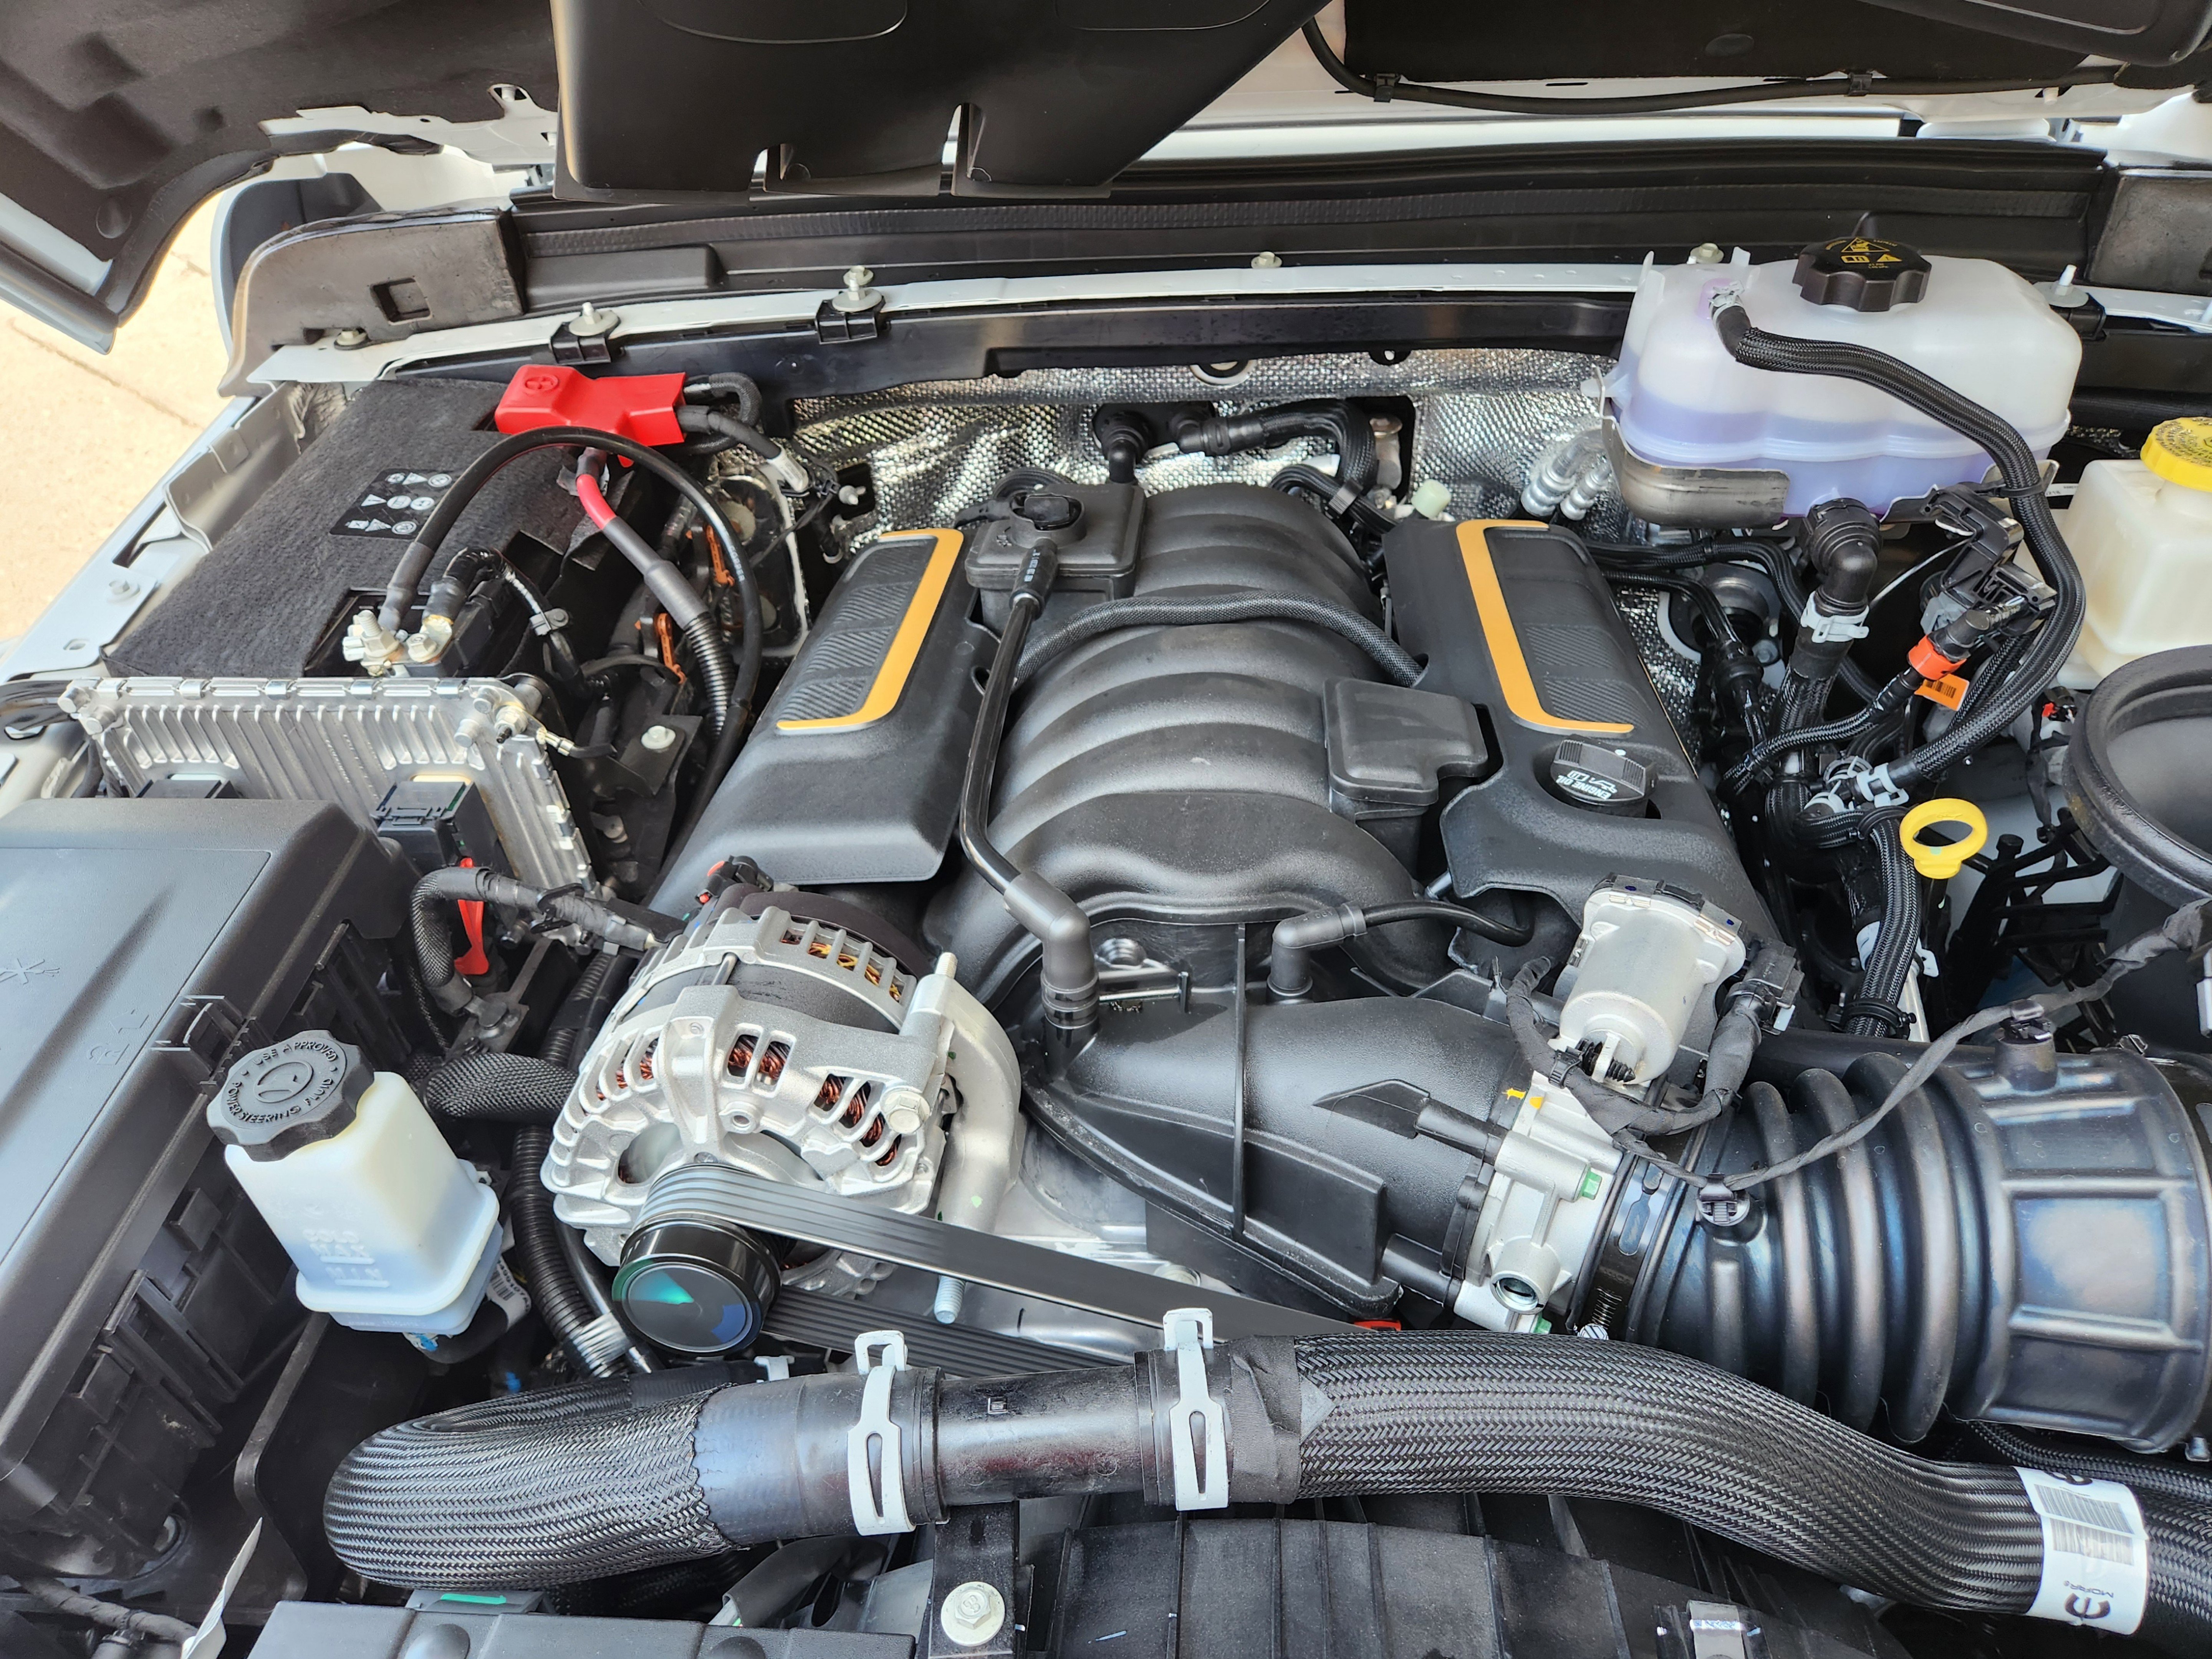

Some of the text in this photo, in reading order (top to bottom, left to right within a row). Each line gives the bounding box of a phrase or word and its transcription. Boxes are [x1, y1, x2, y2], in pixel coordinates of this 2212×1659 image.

[1556, 775, 1612, 801] ENGINE OIL
[253, 1040, 338, 1067] USE APPROVED
[227, 1077, 334, 1124] POWER STEERING FLUID
[310, 1243, 370, 1257] MAX
[325, 1267, 384, 1280] MIN
